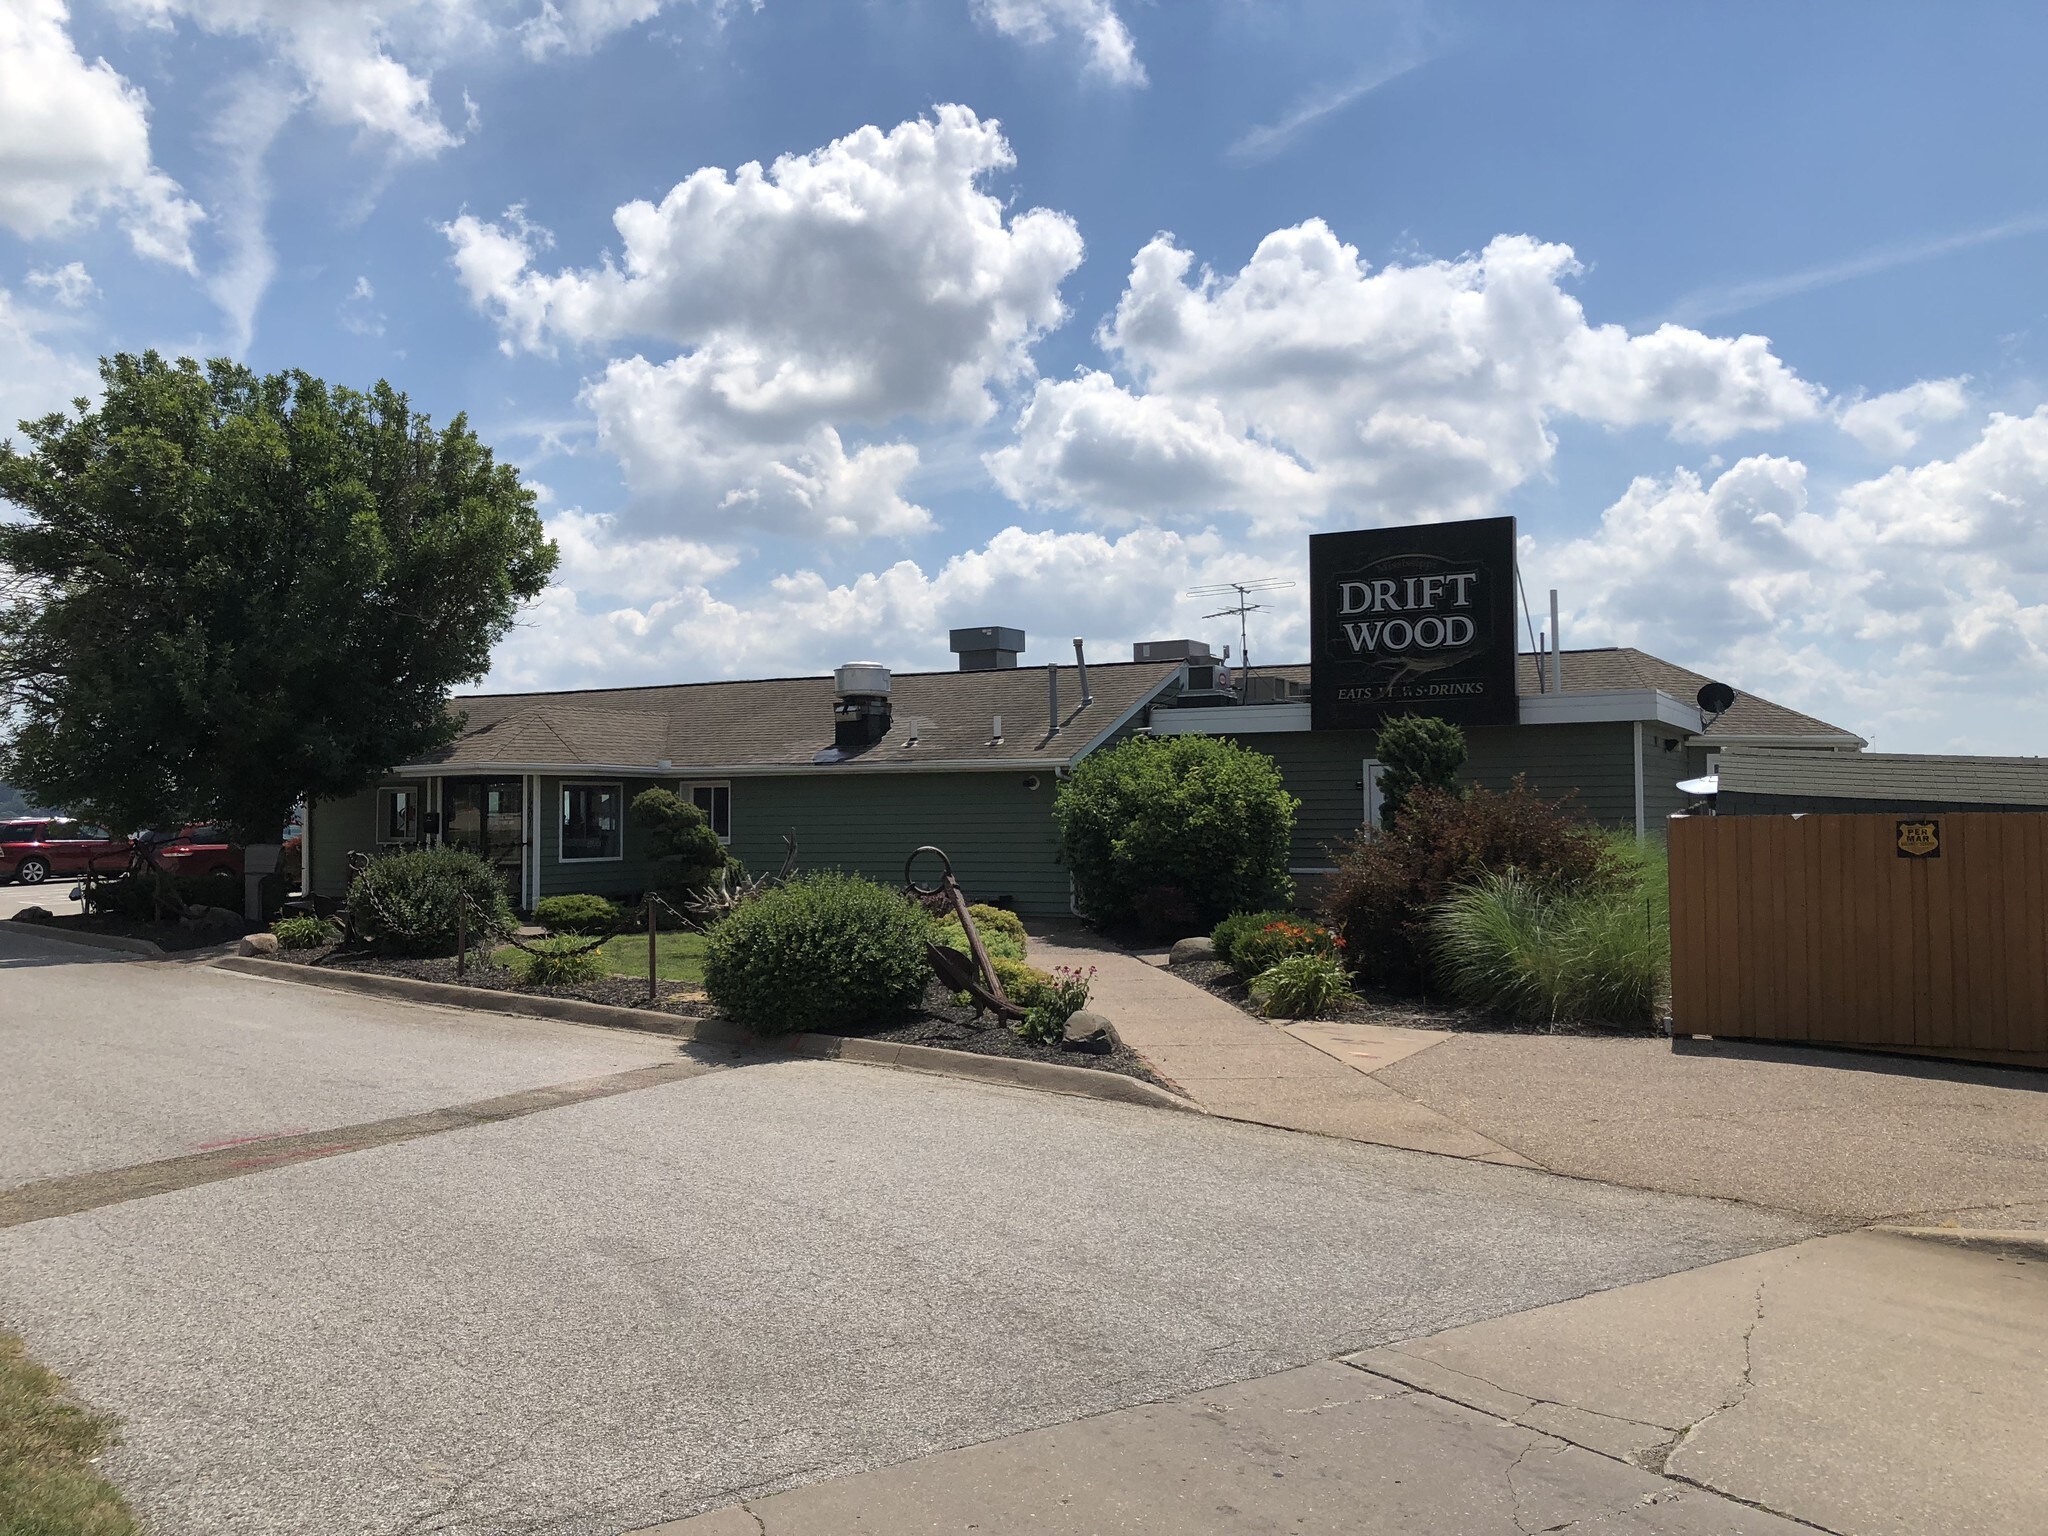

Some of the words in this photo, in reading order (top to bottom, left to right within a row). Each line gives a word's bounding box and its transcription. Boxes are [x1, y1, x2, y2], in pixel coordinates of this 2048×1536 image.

[1339, 573, 1476, 614] DRIFT
[1343, 616, 1475, 652] WOOD
[1338, 687, 1372, 700] EATS
[1429, 682, 1484, 696] DRINKS
